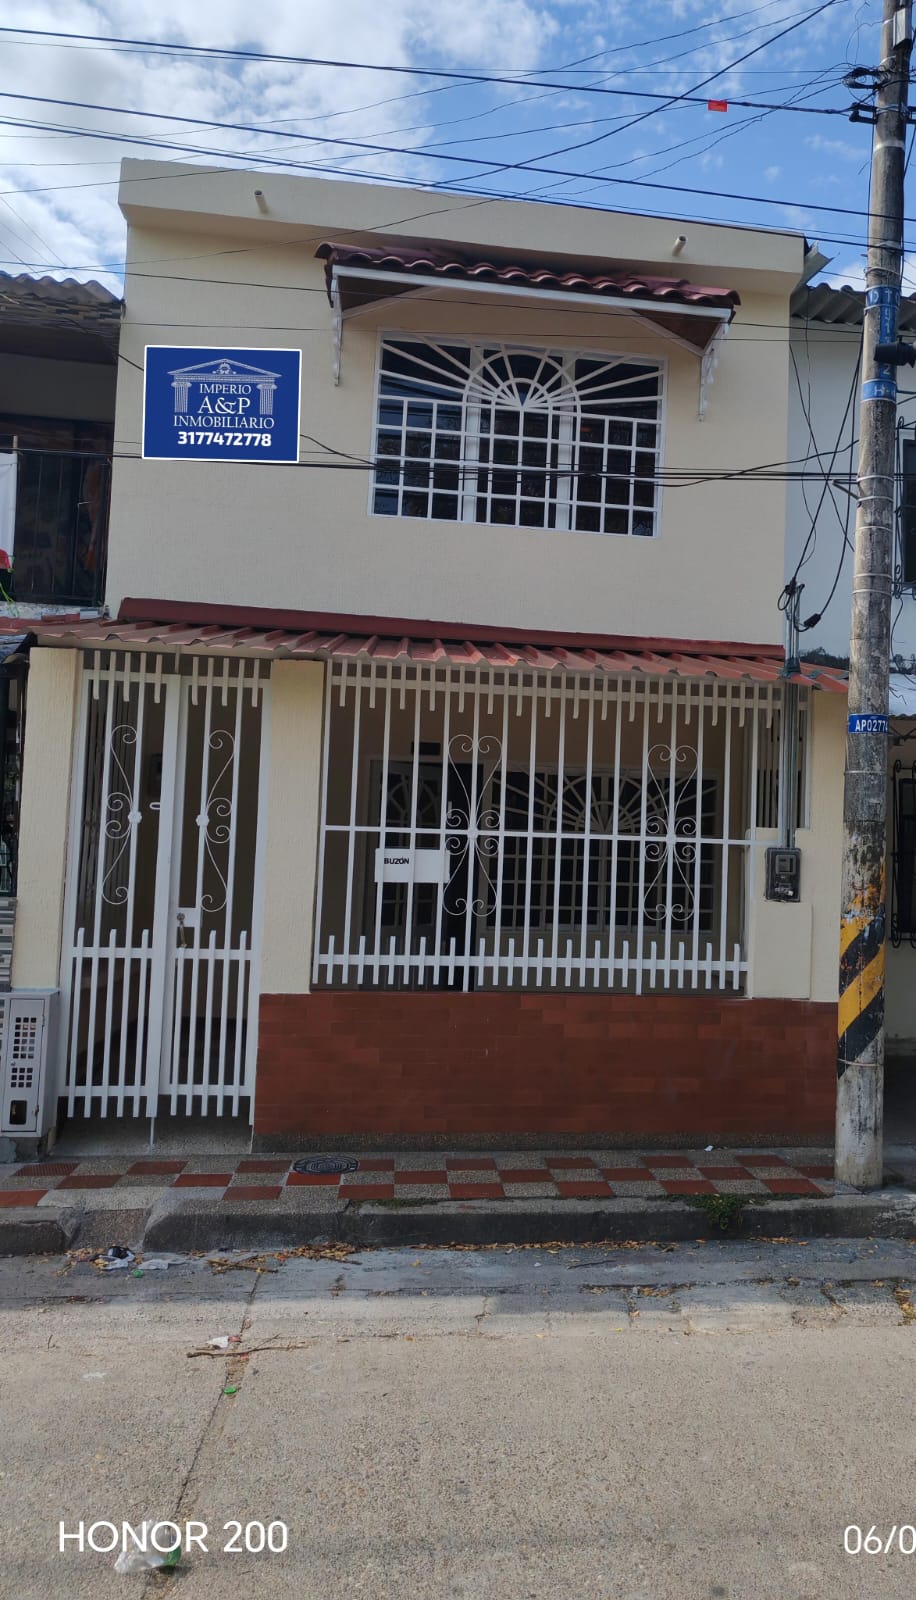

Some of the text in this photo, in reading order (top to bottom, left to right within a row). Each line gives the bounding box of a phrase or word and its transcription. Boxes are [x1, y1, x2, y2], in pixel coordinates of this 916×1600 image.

[199, 383, 252, 395] IMPERIO
[197, 395, 251, 415] A&P
[173, 415, 275, 429] INMOBILIARIO
[177, 431, 272, 447] 3177472778
[383, 856, 410, 865] BUZÓN
